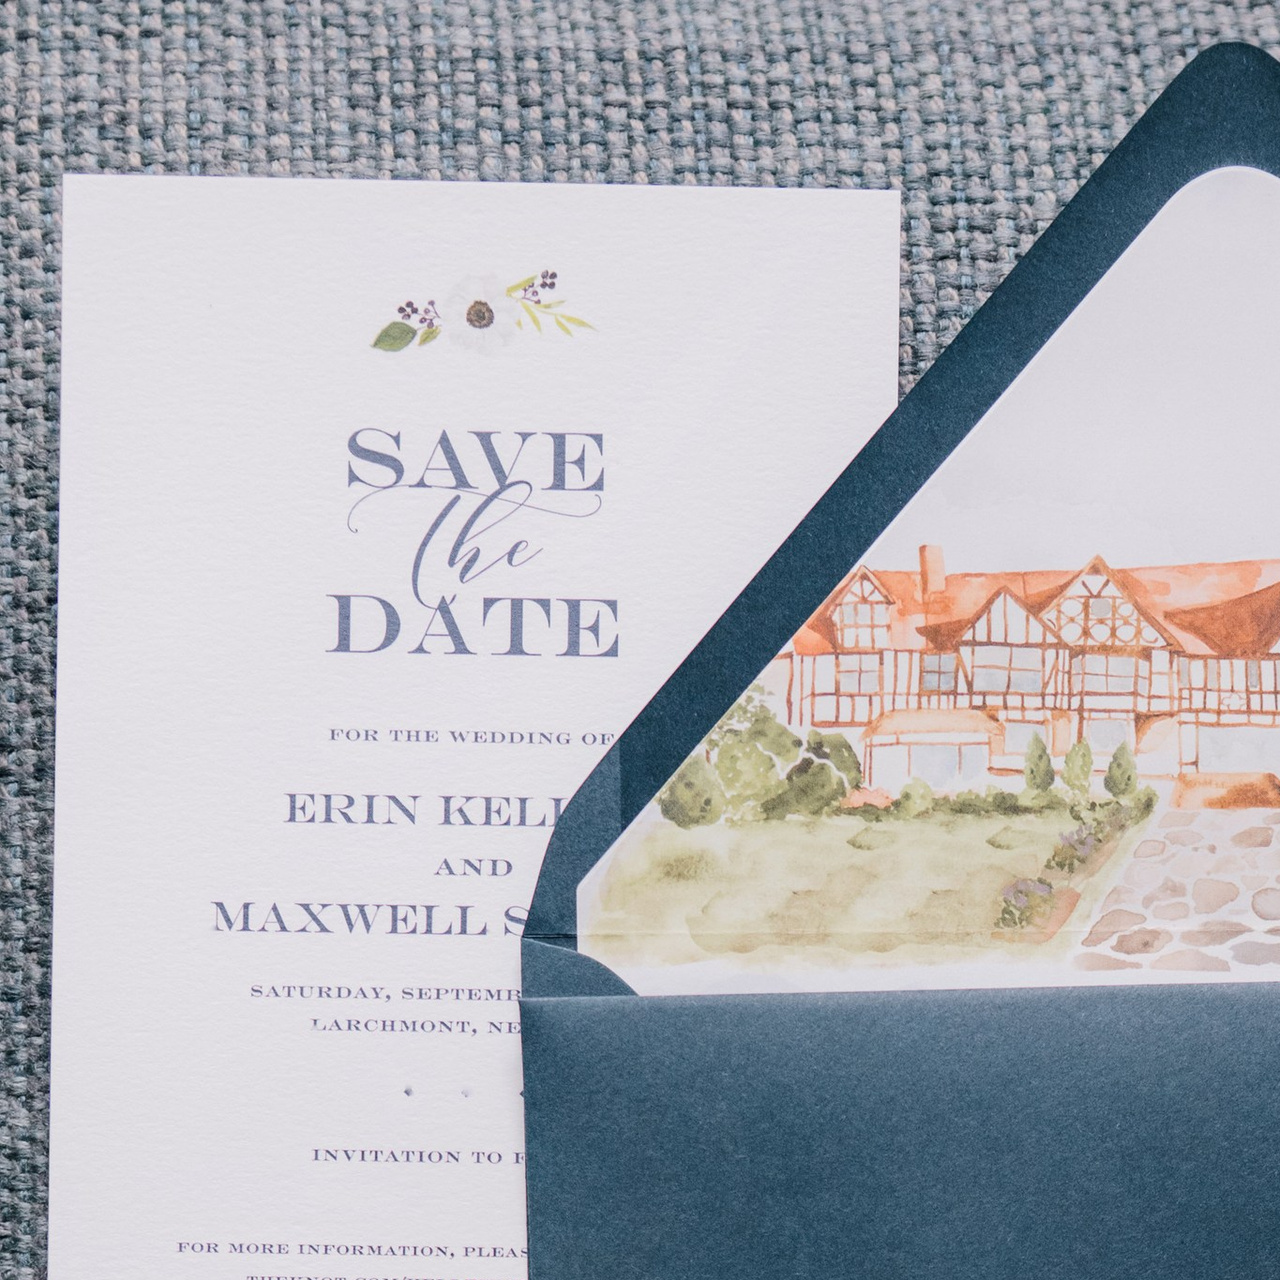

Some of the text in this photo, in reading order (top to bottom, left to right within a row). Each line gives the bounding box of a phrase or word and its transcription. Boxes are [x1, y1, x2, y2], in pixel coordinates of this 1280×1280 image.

[347, 427, 604, 492] SAVE
[325, 593, 619, 658] DATE
[330, 728, 615, 746] FOR THE WEDDING OF
[283, 793, 421, 825] ERIN
[433, 857, 513, 877] AND
[210, 901, 489, 936] MAXWELL
[250, 985, 392, 1003] SATURDAY,
[311, 1018, 478, 1037] LARCHMONT,
[313, 1148, 461, 1163] INVITATION
[471, 1151, 503, 1164] TO
[177, 1242, 219, 1254] FOR
[228, 1242, 289, 1255] MORE
[298, 1244, 455, 1259] INFORMATION,
